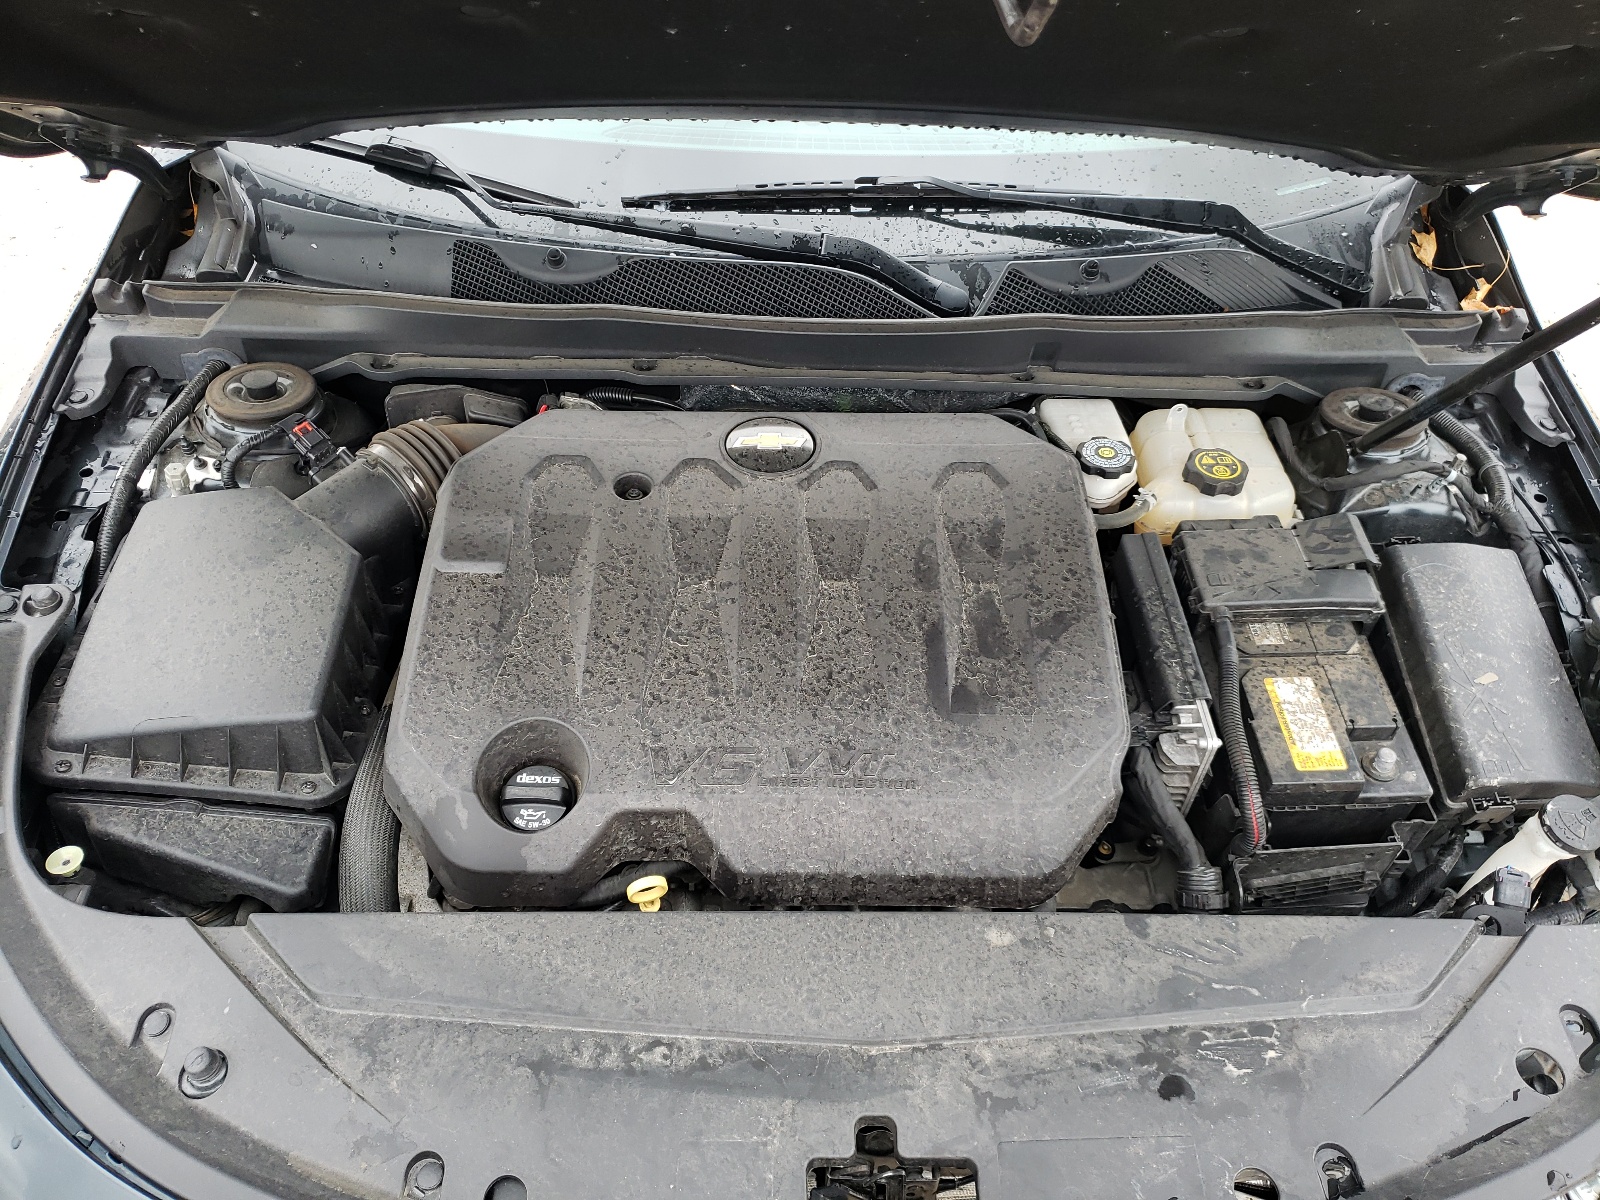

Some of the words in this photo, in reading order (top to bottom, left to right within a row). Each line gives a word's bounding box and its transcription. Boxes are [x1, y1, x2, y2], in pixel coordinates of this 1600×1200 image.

[516, 772, 562, 784] dexos
[513, 816, 528, 828] SAE
[527, 817, 551, 829] 5W-30
